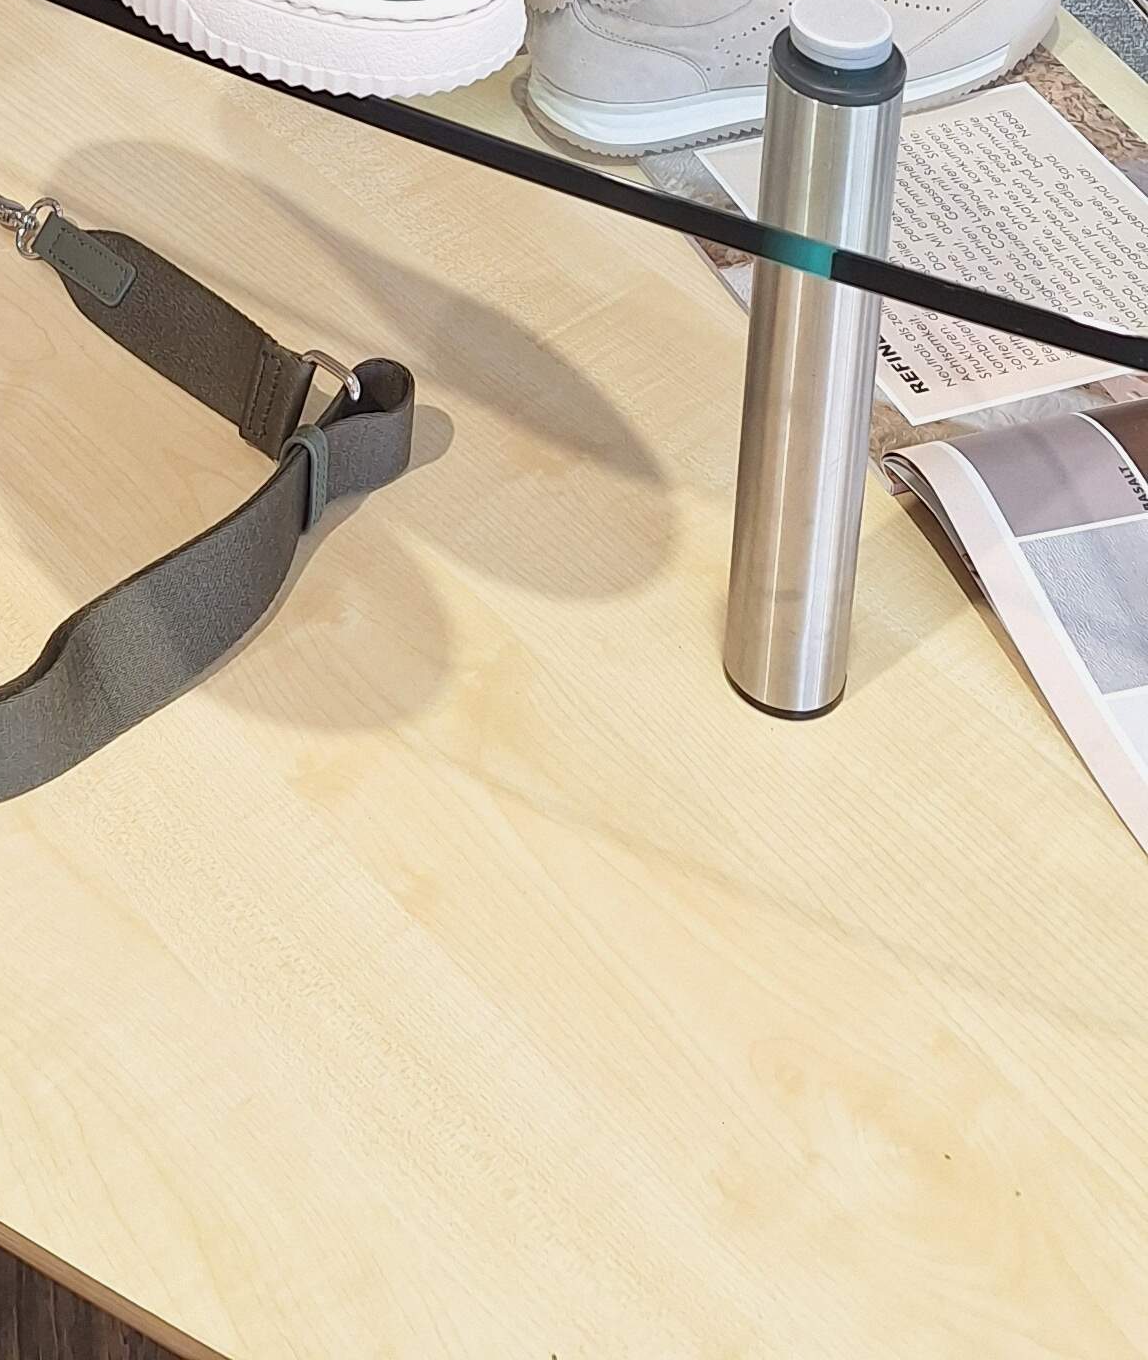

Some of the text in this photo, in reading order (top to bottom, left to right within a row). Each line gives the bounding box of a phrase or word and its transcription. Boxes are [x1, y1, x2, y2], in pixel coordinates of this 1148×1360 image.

[952, 118, 976, 138] sich
[996, 108, 1032, 138] Nebel
[937, 122, 974, 155] sanftes
[968, 116, 1023, 167] Baumwolle
[975, 141, 1012, 174] zeigen
[929, 175, 952, 192] mit
[1010, 177, 1042, 204] Mesh
[1017, 167, 1044, 188] und
[947, 192, 982, 224] Luxury
[981, 187, 999, 201] zu
[1002, 189, 1041, 224] Mattes
[1042, 189, 1080, 223] Leinen
[1092, 184, 1120, 205] und
[895, 197, 928, 229] einem
[924, 210, 953, 235] aber
[998, 204, 1028, 231] ohne
[896, 160, 1036, 301] Looks strahlen Gelassenheit
[923, 231, 946, 248] Mit
[974, 223, 1005, 249] Cool
[994, 220, 1047, 270] reduzierte
[1041, 208, 1118, 280] schimmerndes
[922, 249, 947, 271] Das
[1063, 253, 1088, 270] mit
[1093, 239, 1124, 267] denn
[976, 264, 997, 281] nie
[1081, 288, 1107, 310] sich
[1084, 271, 1142, 328] Materialien
[897, 326, 917, 342] als
[951, 320, 1009, 375] kombiniert
[877, 335, 930, 394] REFIN
[912, 342, 958, 388] Neutrals
[987, 333, 1027, 371] softem
